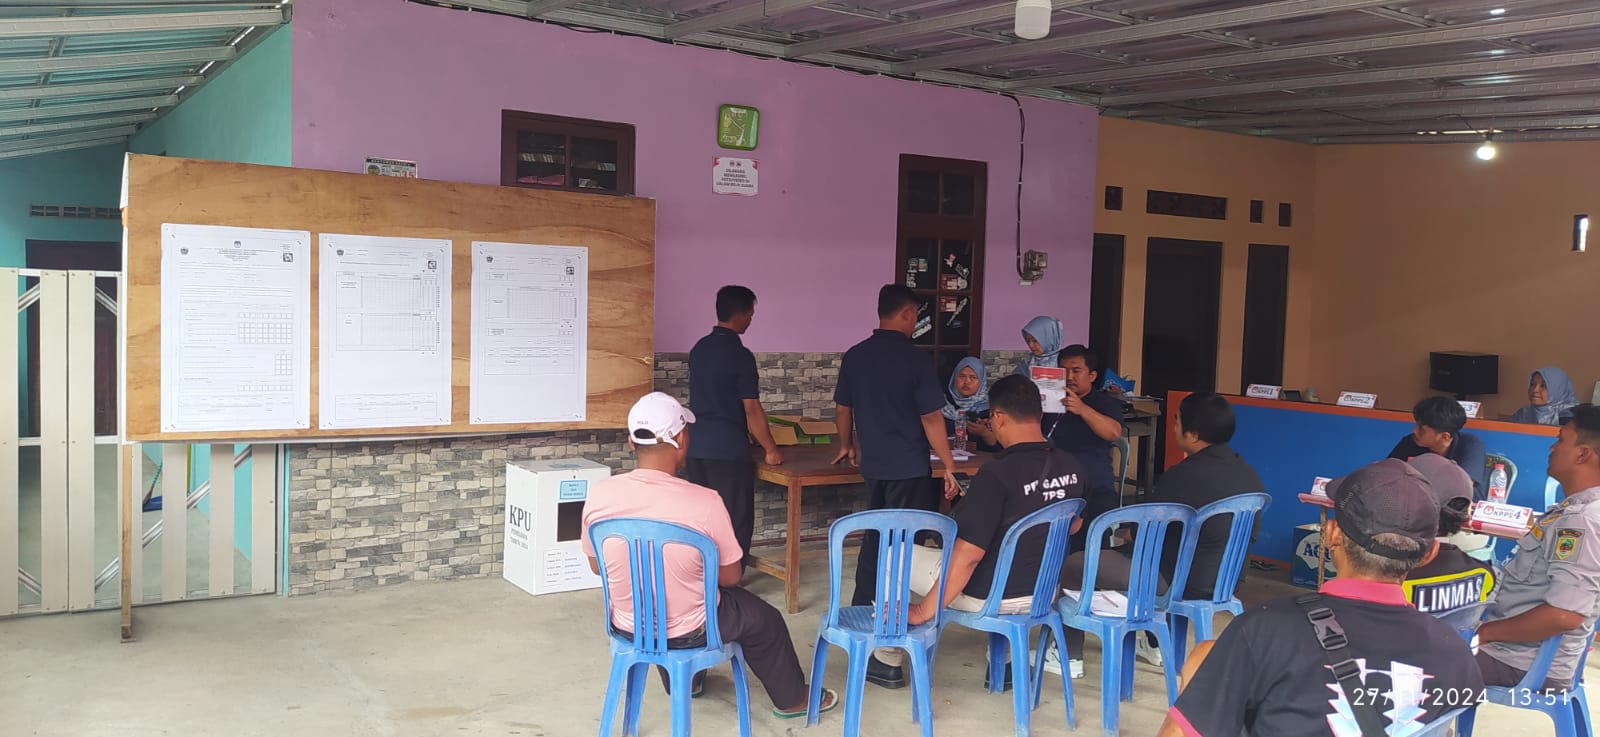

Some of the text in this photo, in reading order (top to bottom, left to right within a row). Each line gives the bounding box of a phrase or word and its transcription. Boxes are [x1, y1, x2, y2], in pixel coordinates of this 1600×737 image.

[1042, 488, 1066, 502] TPS
[509, 504, 531, 532] KPU
[1513, 510, 1522, 520] 4
[1418, 575, 1483, 612] LINMAS
